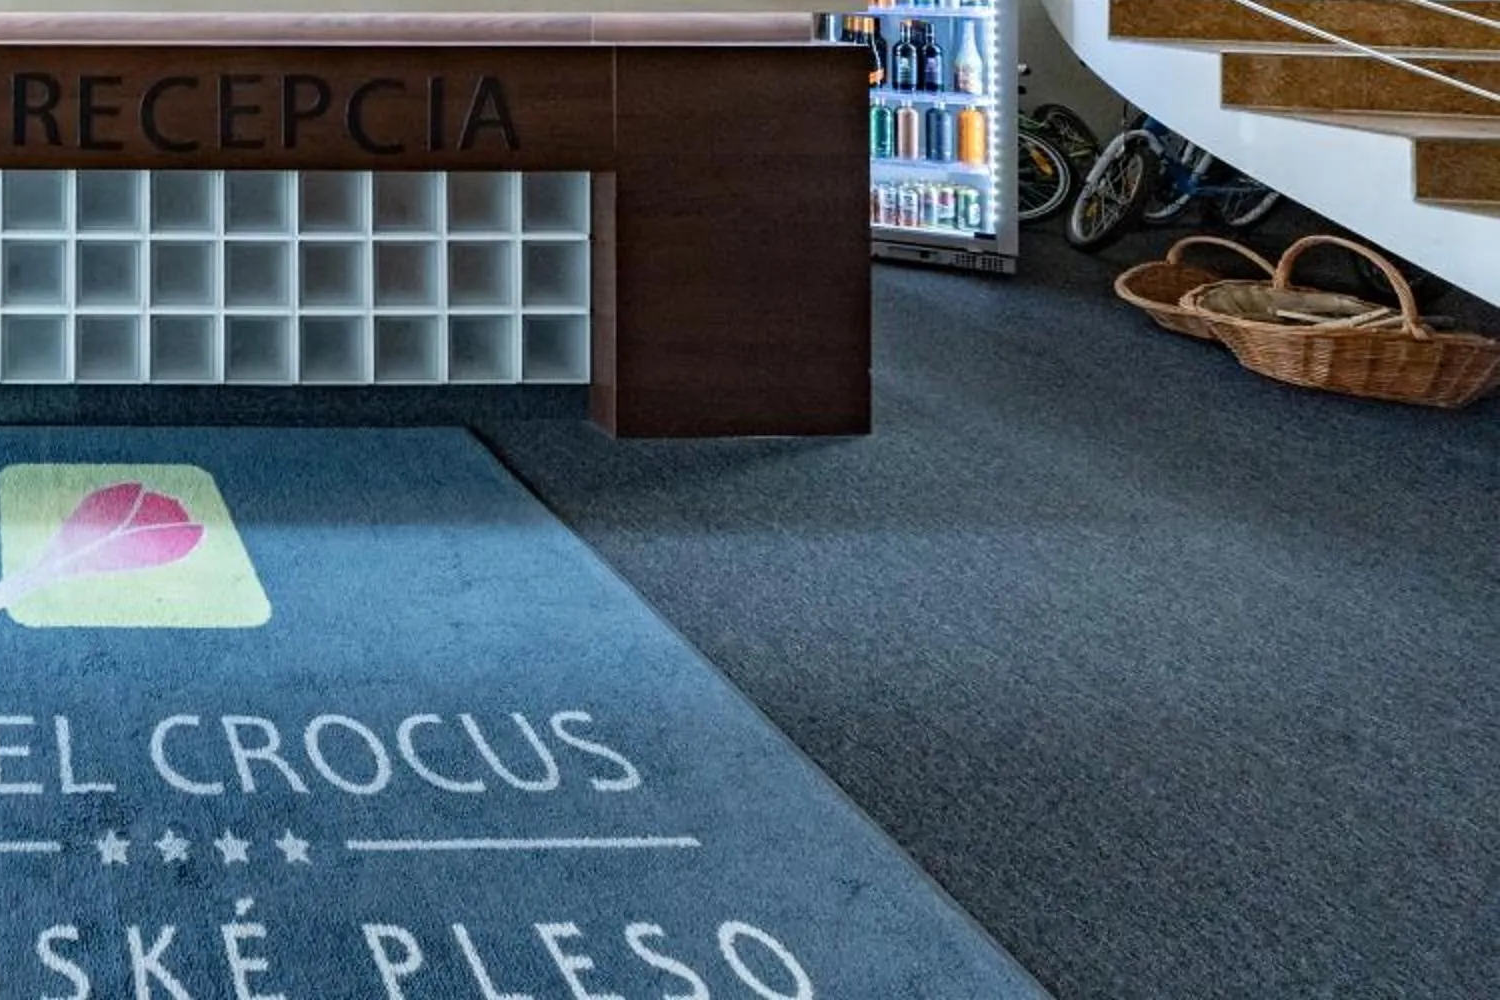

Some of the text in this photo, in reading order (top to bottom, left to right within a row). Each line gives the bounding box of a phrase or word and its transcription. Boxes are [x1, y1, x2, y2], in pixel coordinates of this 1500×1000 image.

[10, 71, 521, 155] RECEPCIA
[149, 710, 642, 795] CROCUS
[361, 918, 815, 1000] PLESO
